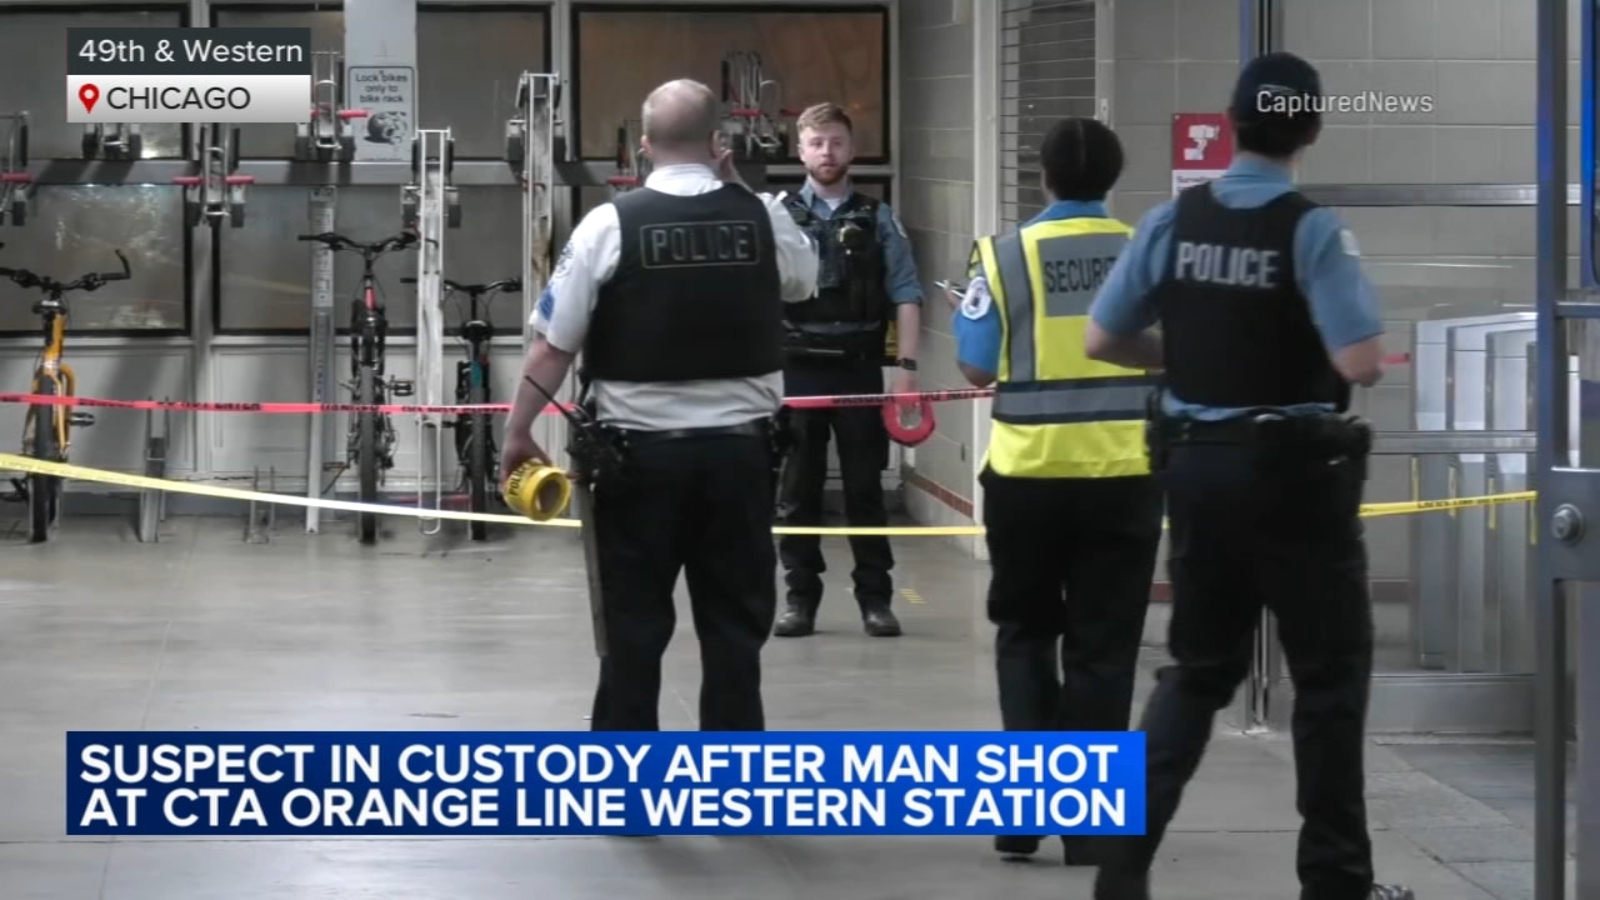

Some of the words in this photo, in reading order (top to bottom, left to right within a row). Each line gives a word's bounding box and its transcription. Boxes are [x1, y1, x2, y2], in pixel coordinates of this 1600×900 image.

[355, 73, 379, 82] Lock
[381, 73, 408, 82] bikes
[364, 84, 386, 94] only
[388, 84, 399, 93] to
[650, 224, 750, 263] POLICE
[1175, 241, 1280, 289] POLICE
